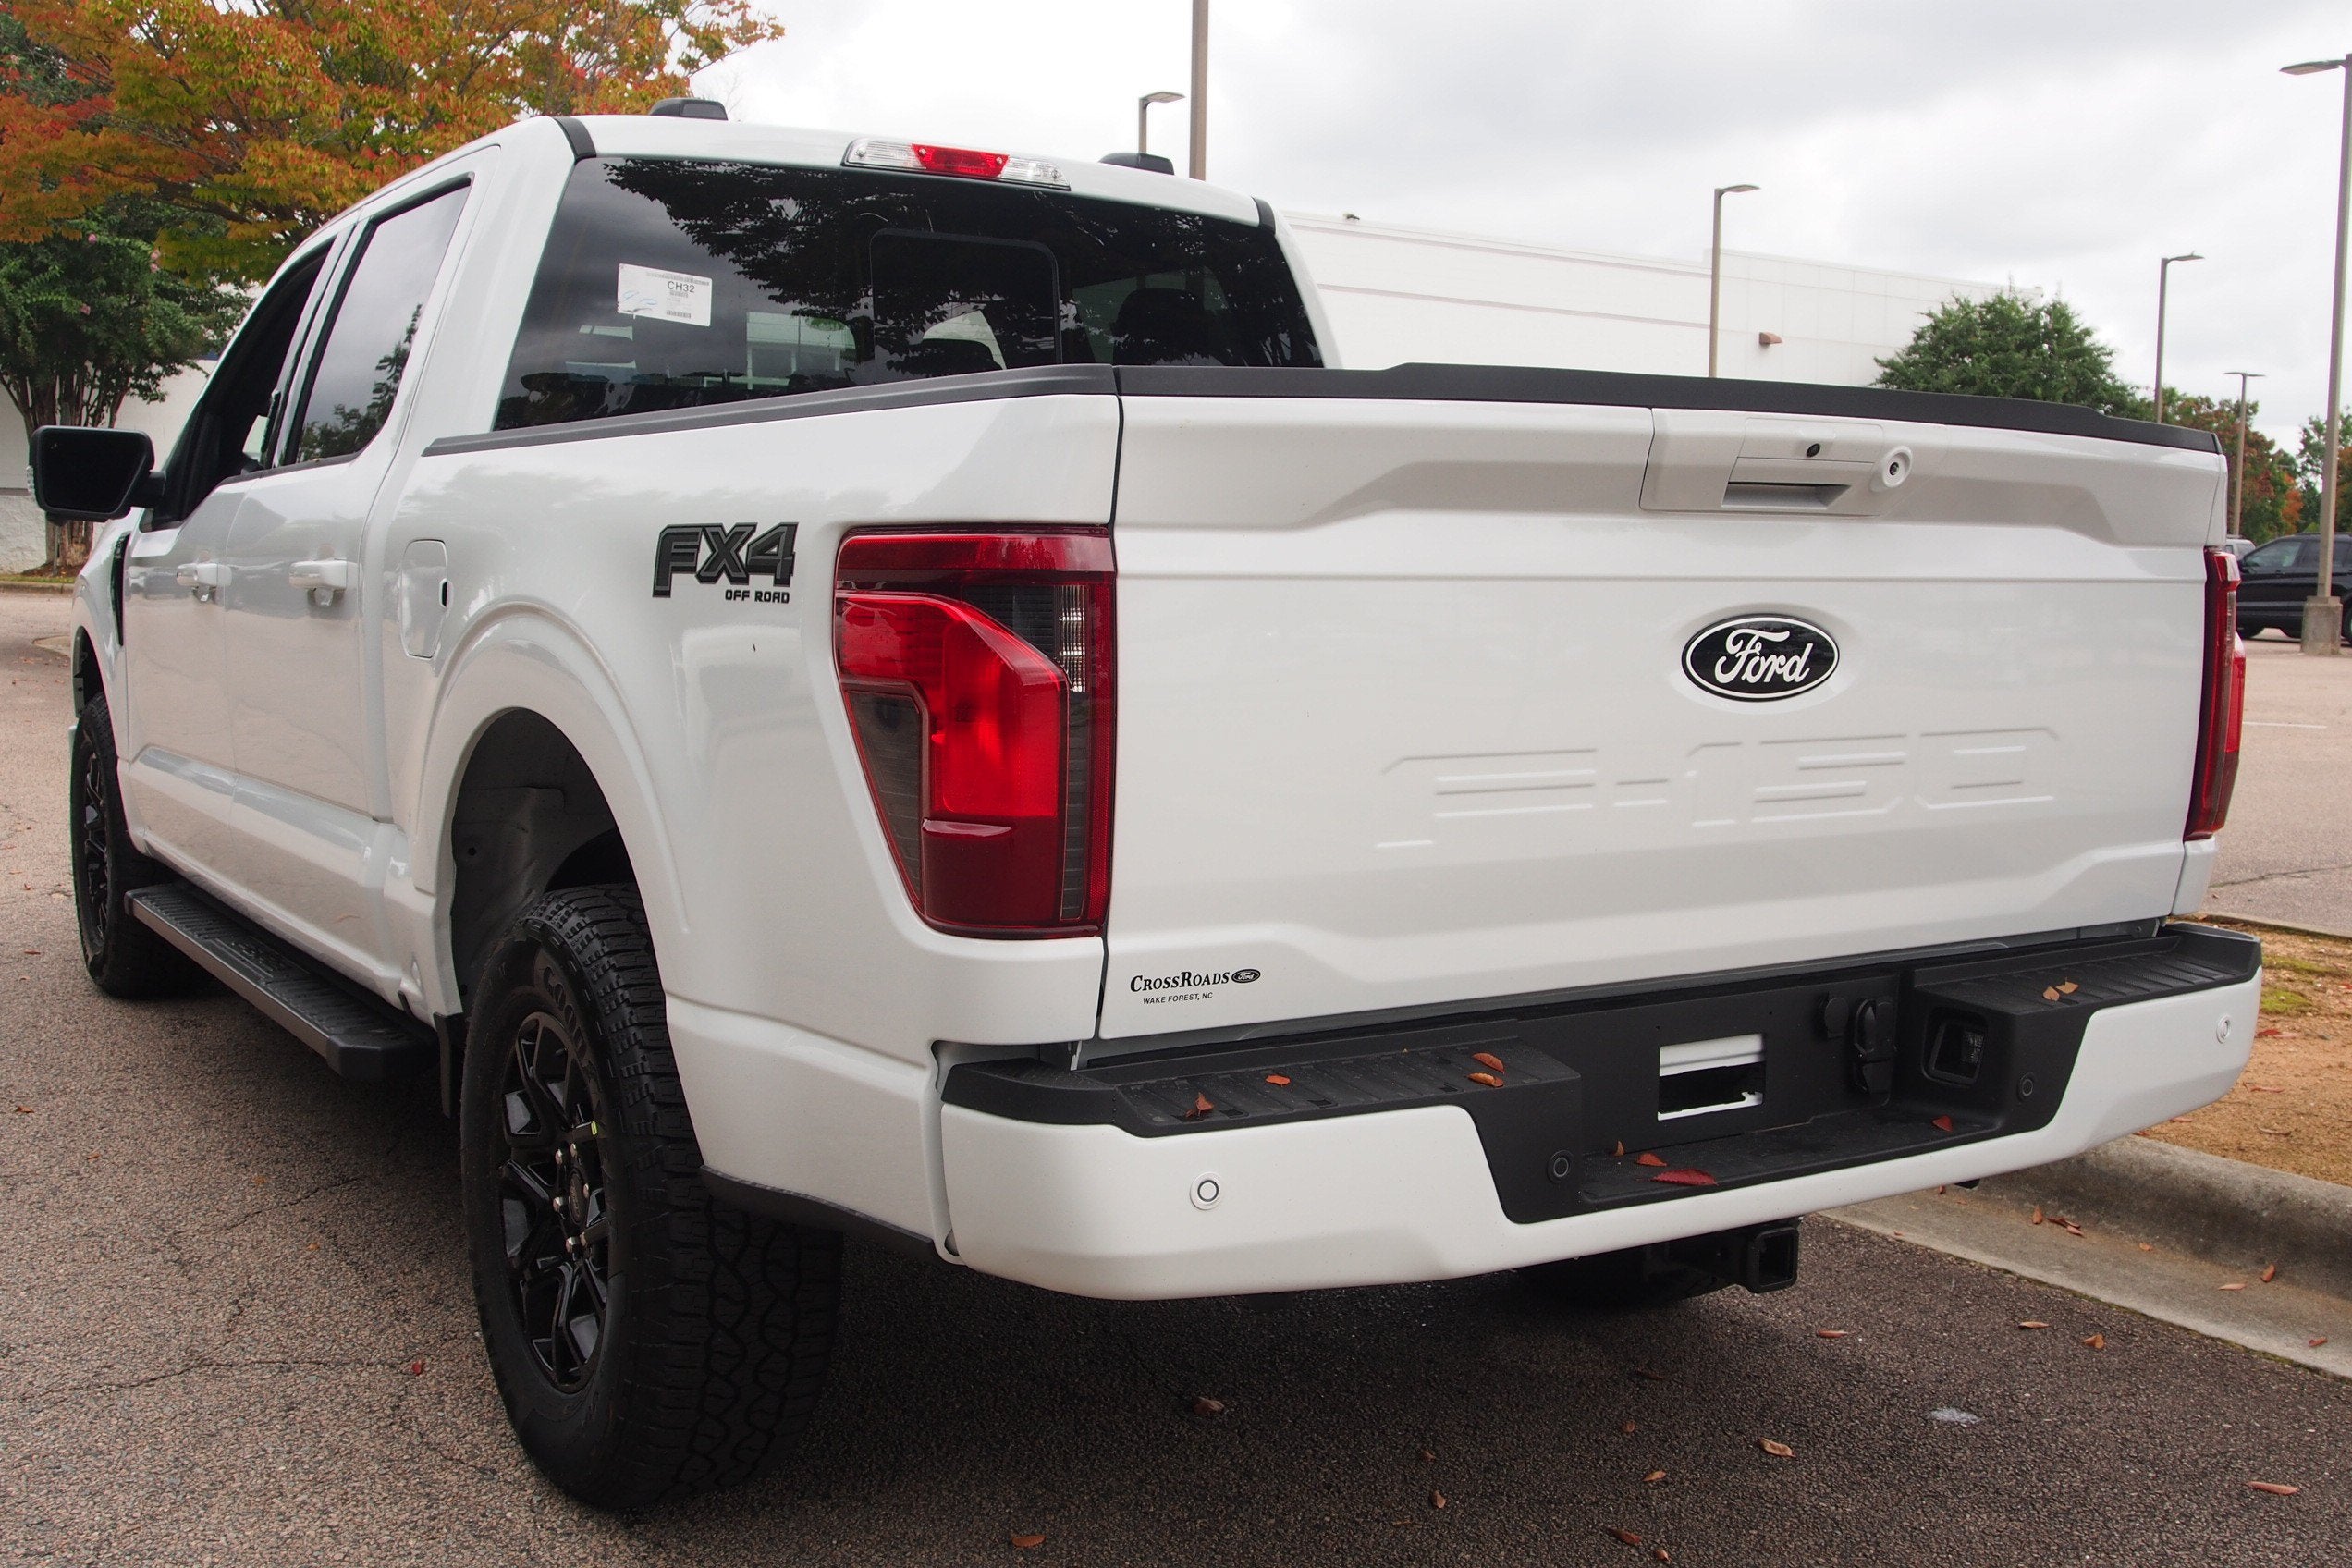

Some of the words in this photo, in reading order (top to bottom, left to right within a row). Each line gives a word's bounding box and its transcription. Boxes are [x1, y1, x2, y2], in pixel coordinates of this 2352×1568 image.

[667, 280, 695, 293] CH32
[652, 521, 799, 598] FX4
[725, 589, 750, 601] OFF
[754, 590, 790, 604] ROAD
[1714, 628, 1814, 684] Ford
[1143, 996, 1166, 1005] WAKE
[1168, 993, 1200, 1002] FOREST,
[1202, 991, 1213, 999] NC
